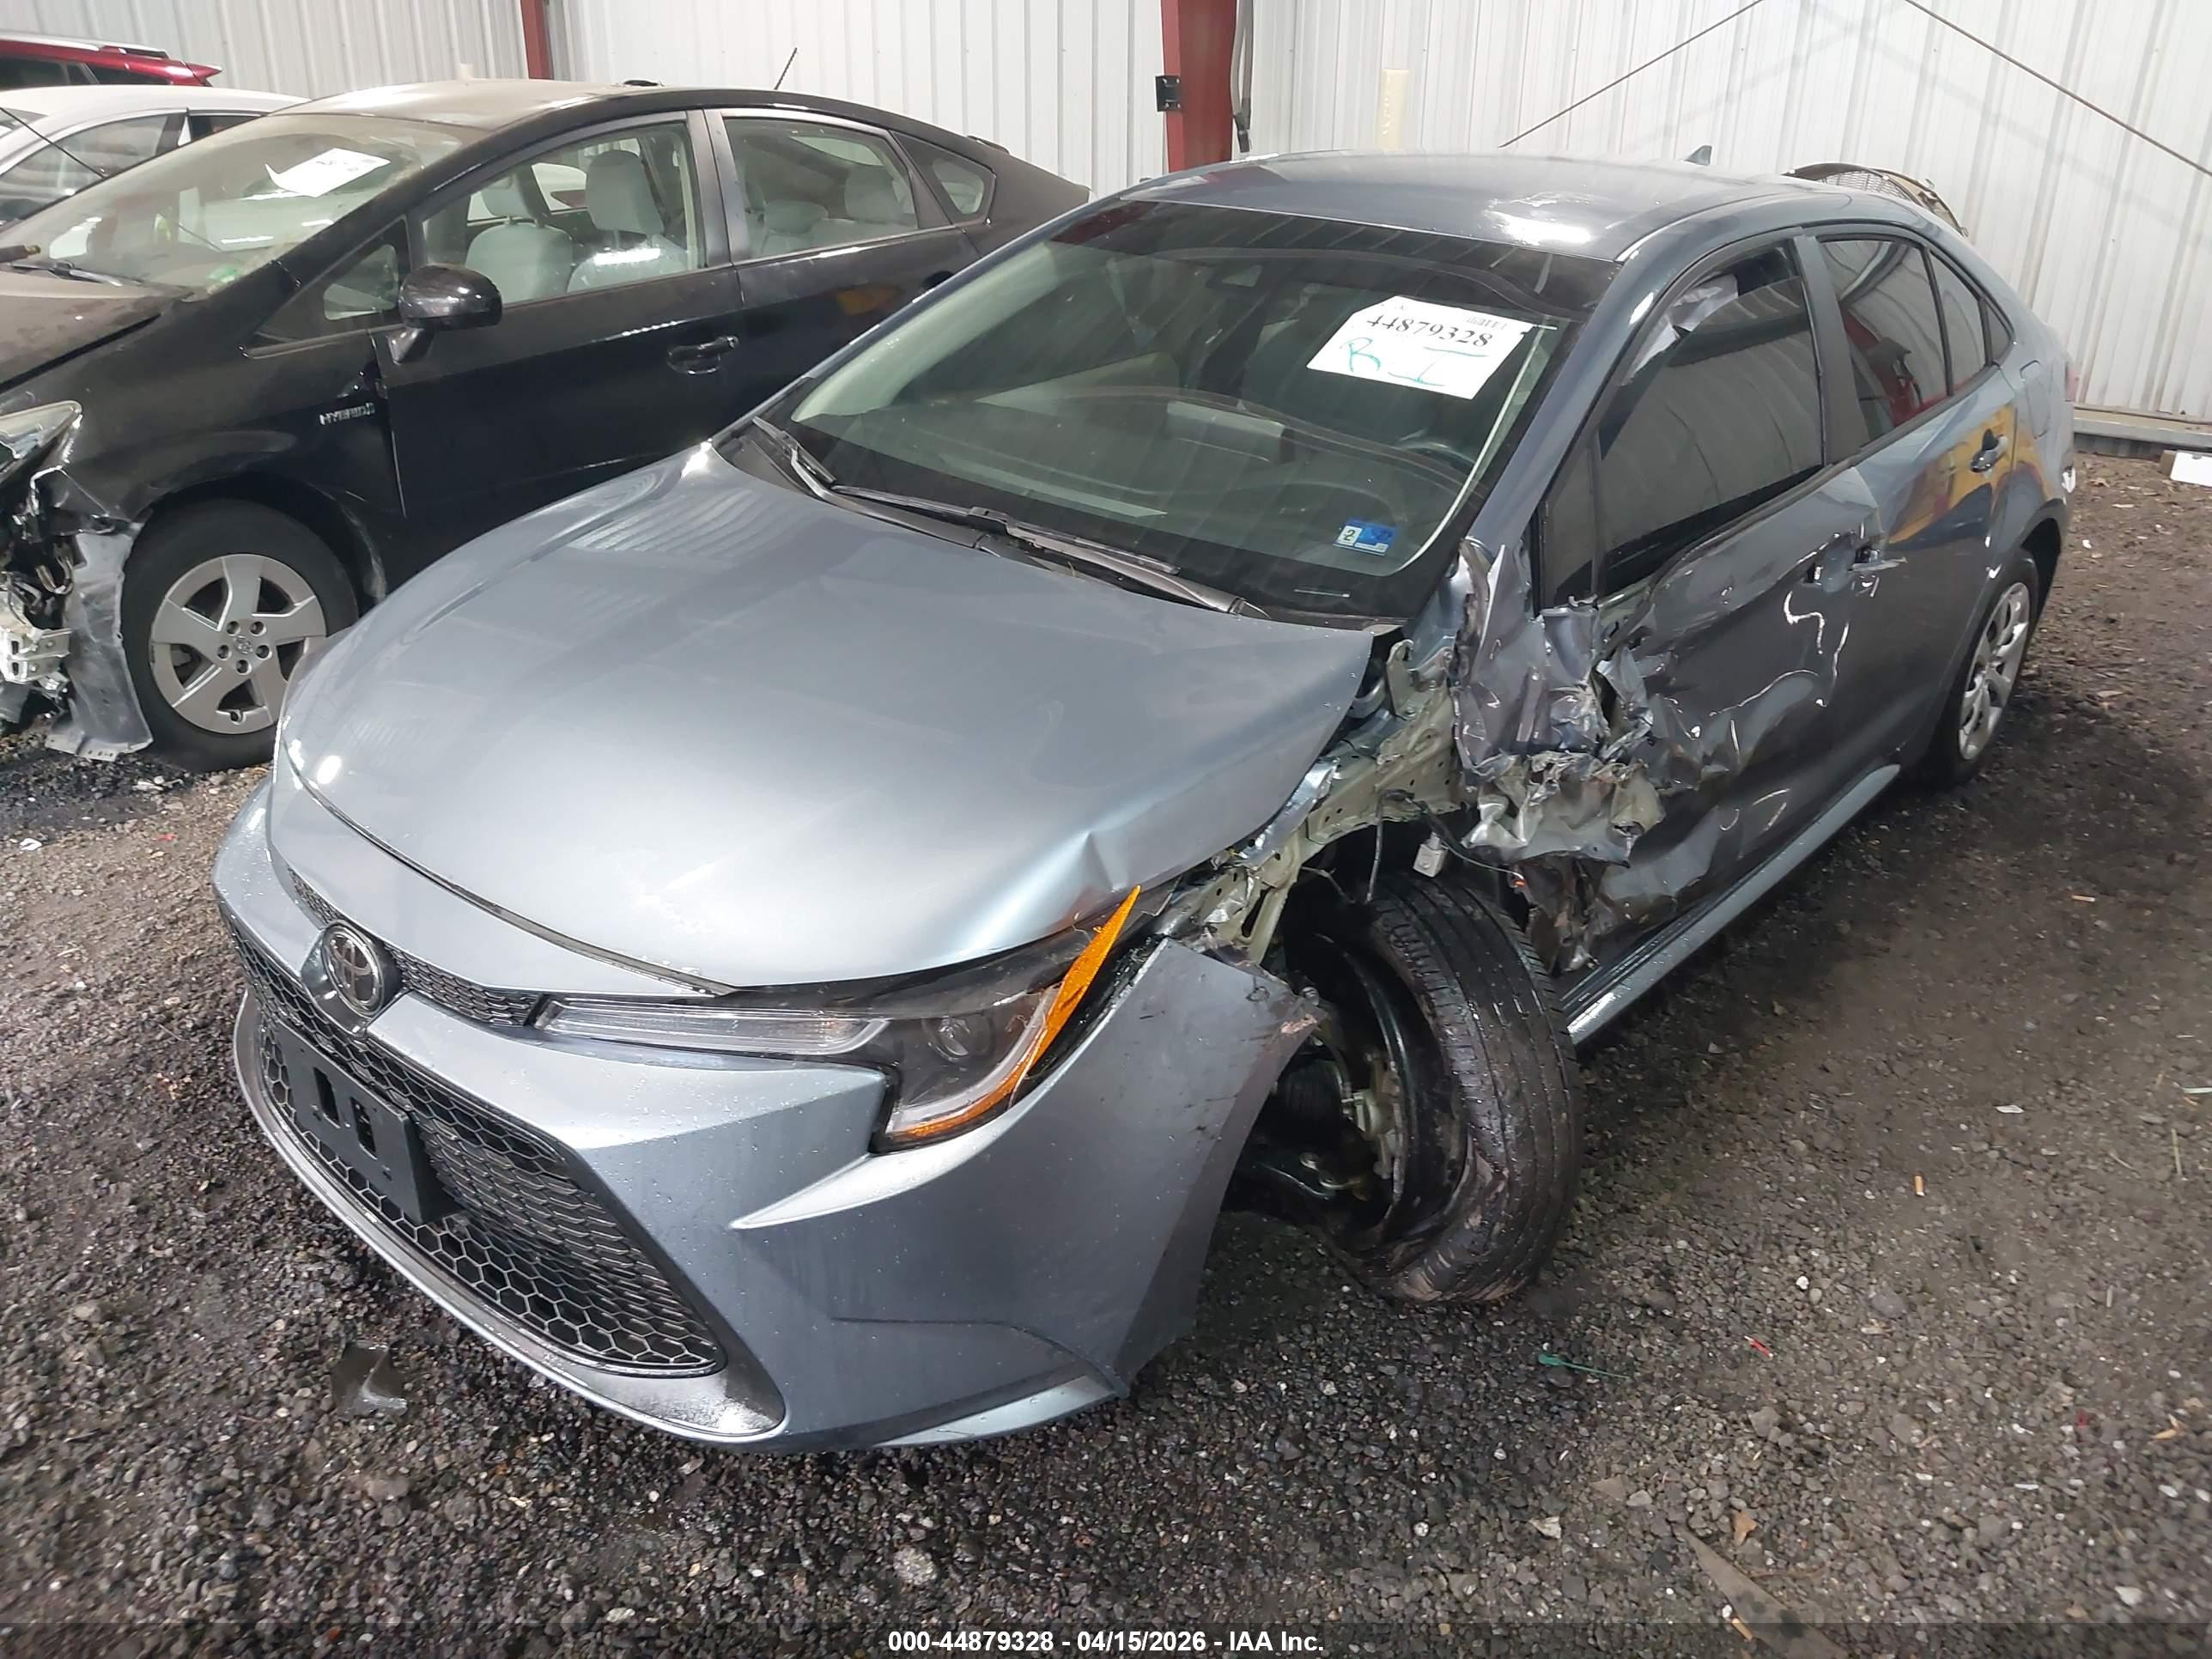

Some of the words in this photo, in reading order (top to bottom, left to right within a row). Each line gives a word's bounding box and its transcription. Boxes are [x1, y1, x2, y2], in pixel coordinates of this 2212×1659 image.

[1366, 314, 1493, 347] 44879328
[319, 405, 367, 425] HYBRID
[1343, 529, 1356, 541] 2
